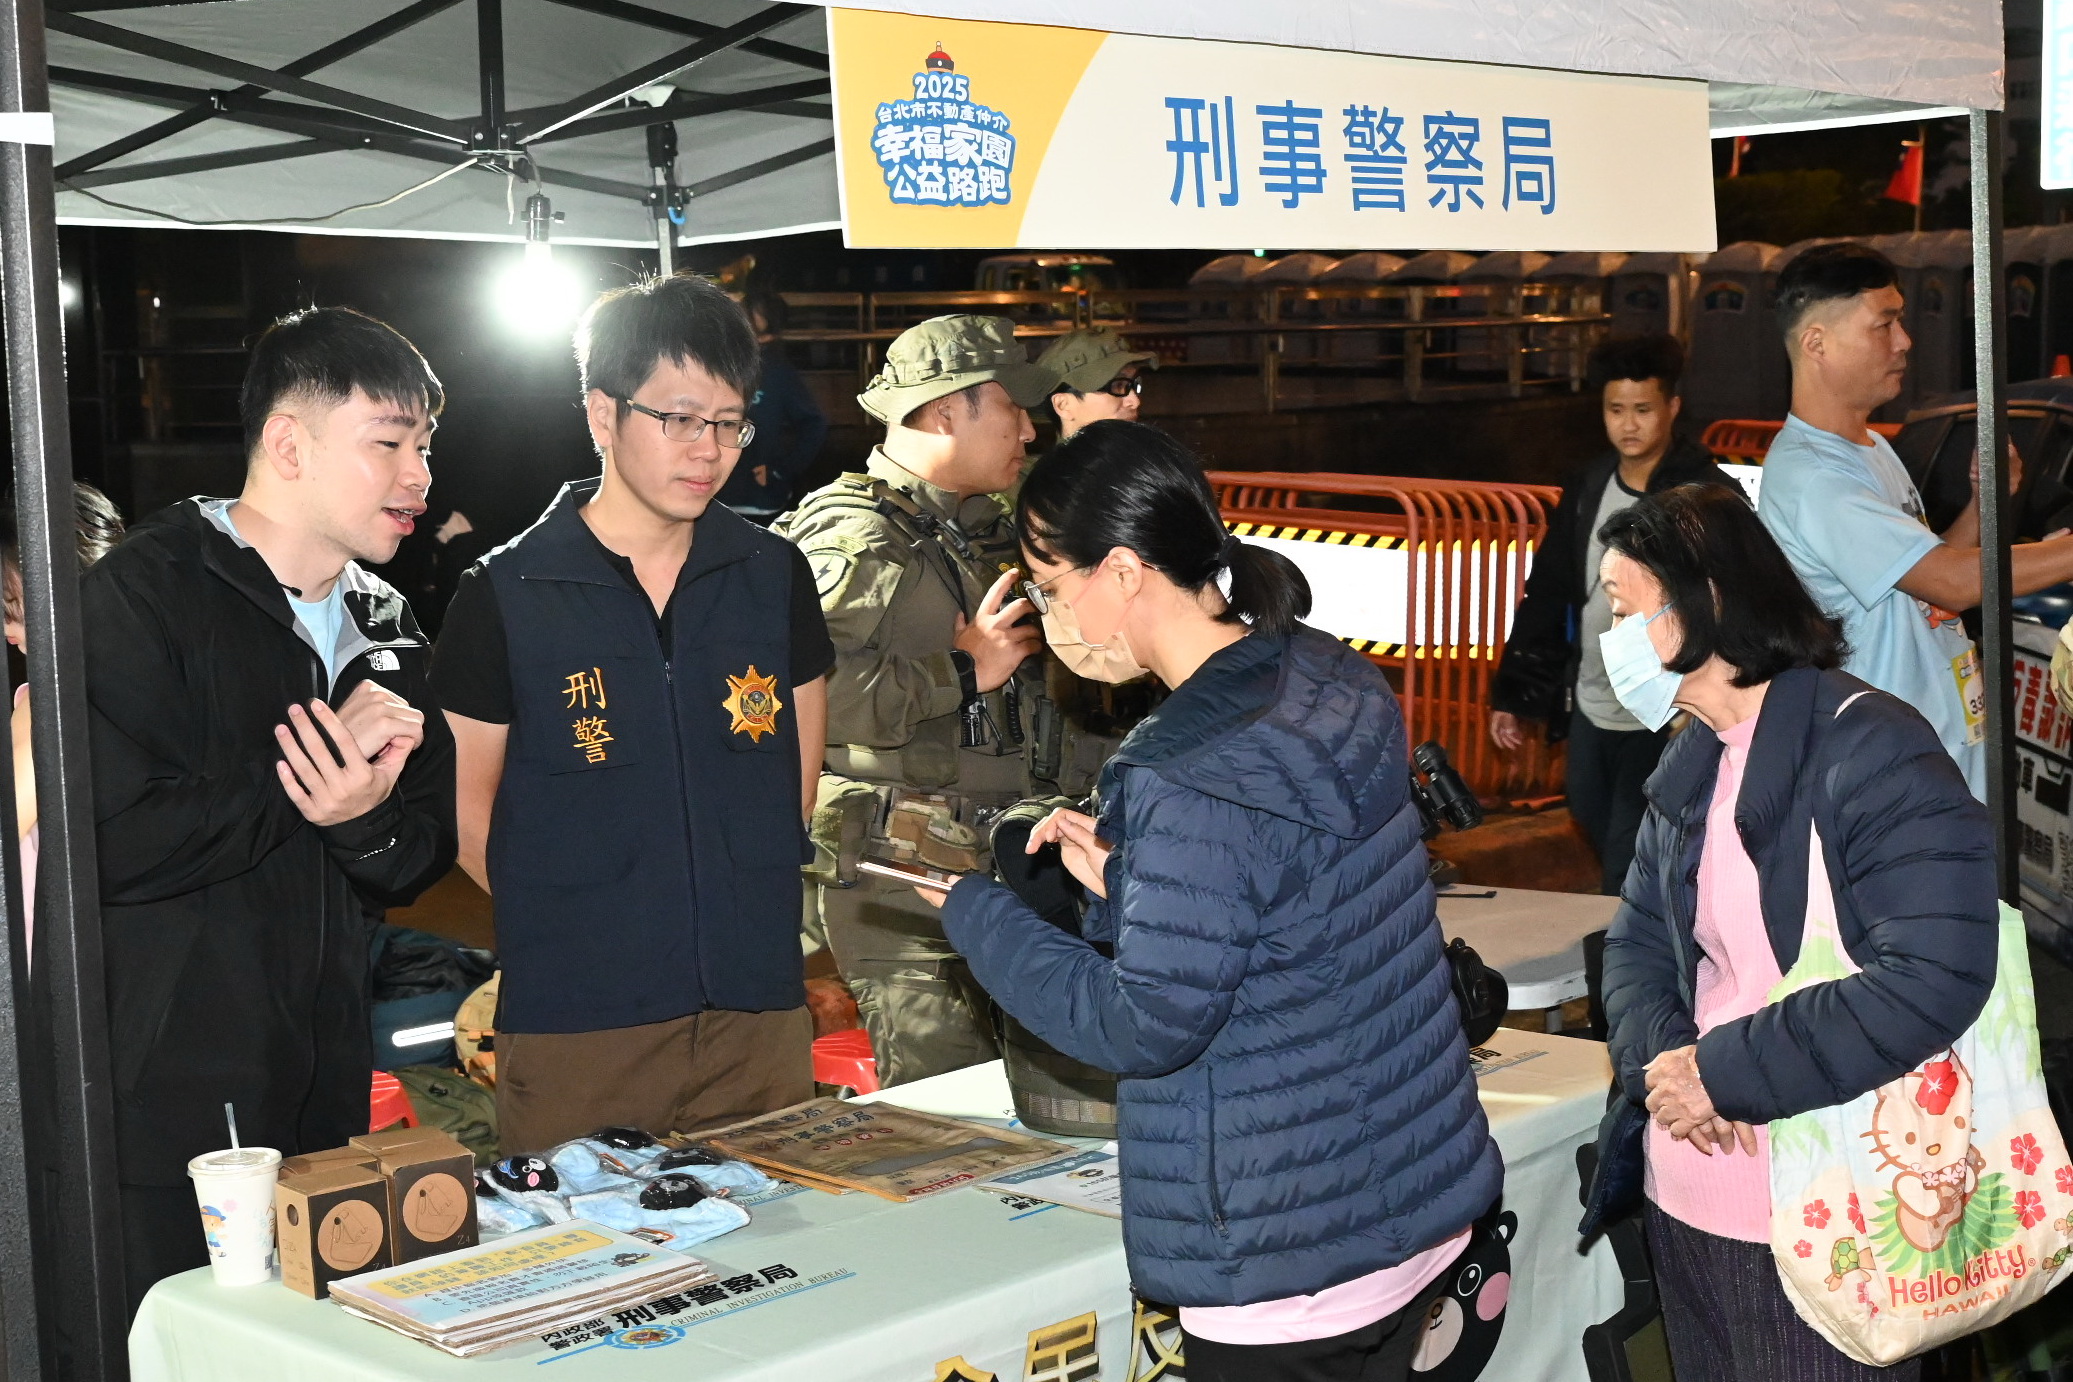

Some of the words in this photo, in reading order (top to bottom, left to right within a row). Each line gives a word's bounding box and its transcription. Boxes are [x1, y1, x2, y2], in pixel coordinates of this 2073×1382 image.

[914, 75, 968, 101] 2025
[877, 101, 1008, 131] 台北市不動產仲介
[875, 122, 1012, 168] 幸福家園
[1164, 95, 1559, 217] 刑事警察局
[887, 161, 1008, 201] 公益路跑
[561, 666, 615, 764] 刑警
[611, 1263, 799, 1330] 刑事警察局
[670, 1307, 724, 1327] CRIMINAL
[726, 1281, 804, 1310] INVESTIGATION
[807, 1267, 849, 1284] BUREAU
[1888, 1274, 1961, 1307] Hello
[1964, 1244, 2027, 1291] Kitty
[1922, 1284, 2011, 1320] HAWAII
[540, 1317, 606, 1343] 內政部
